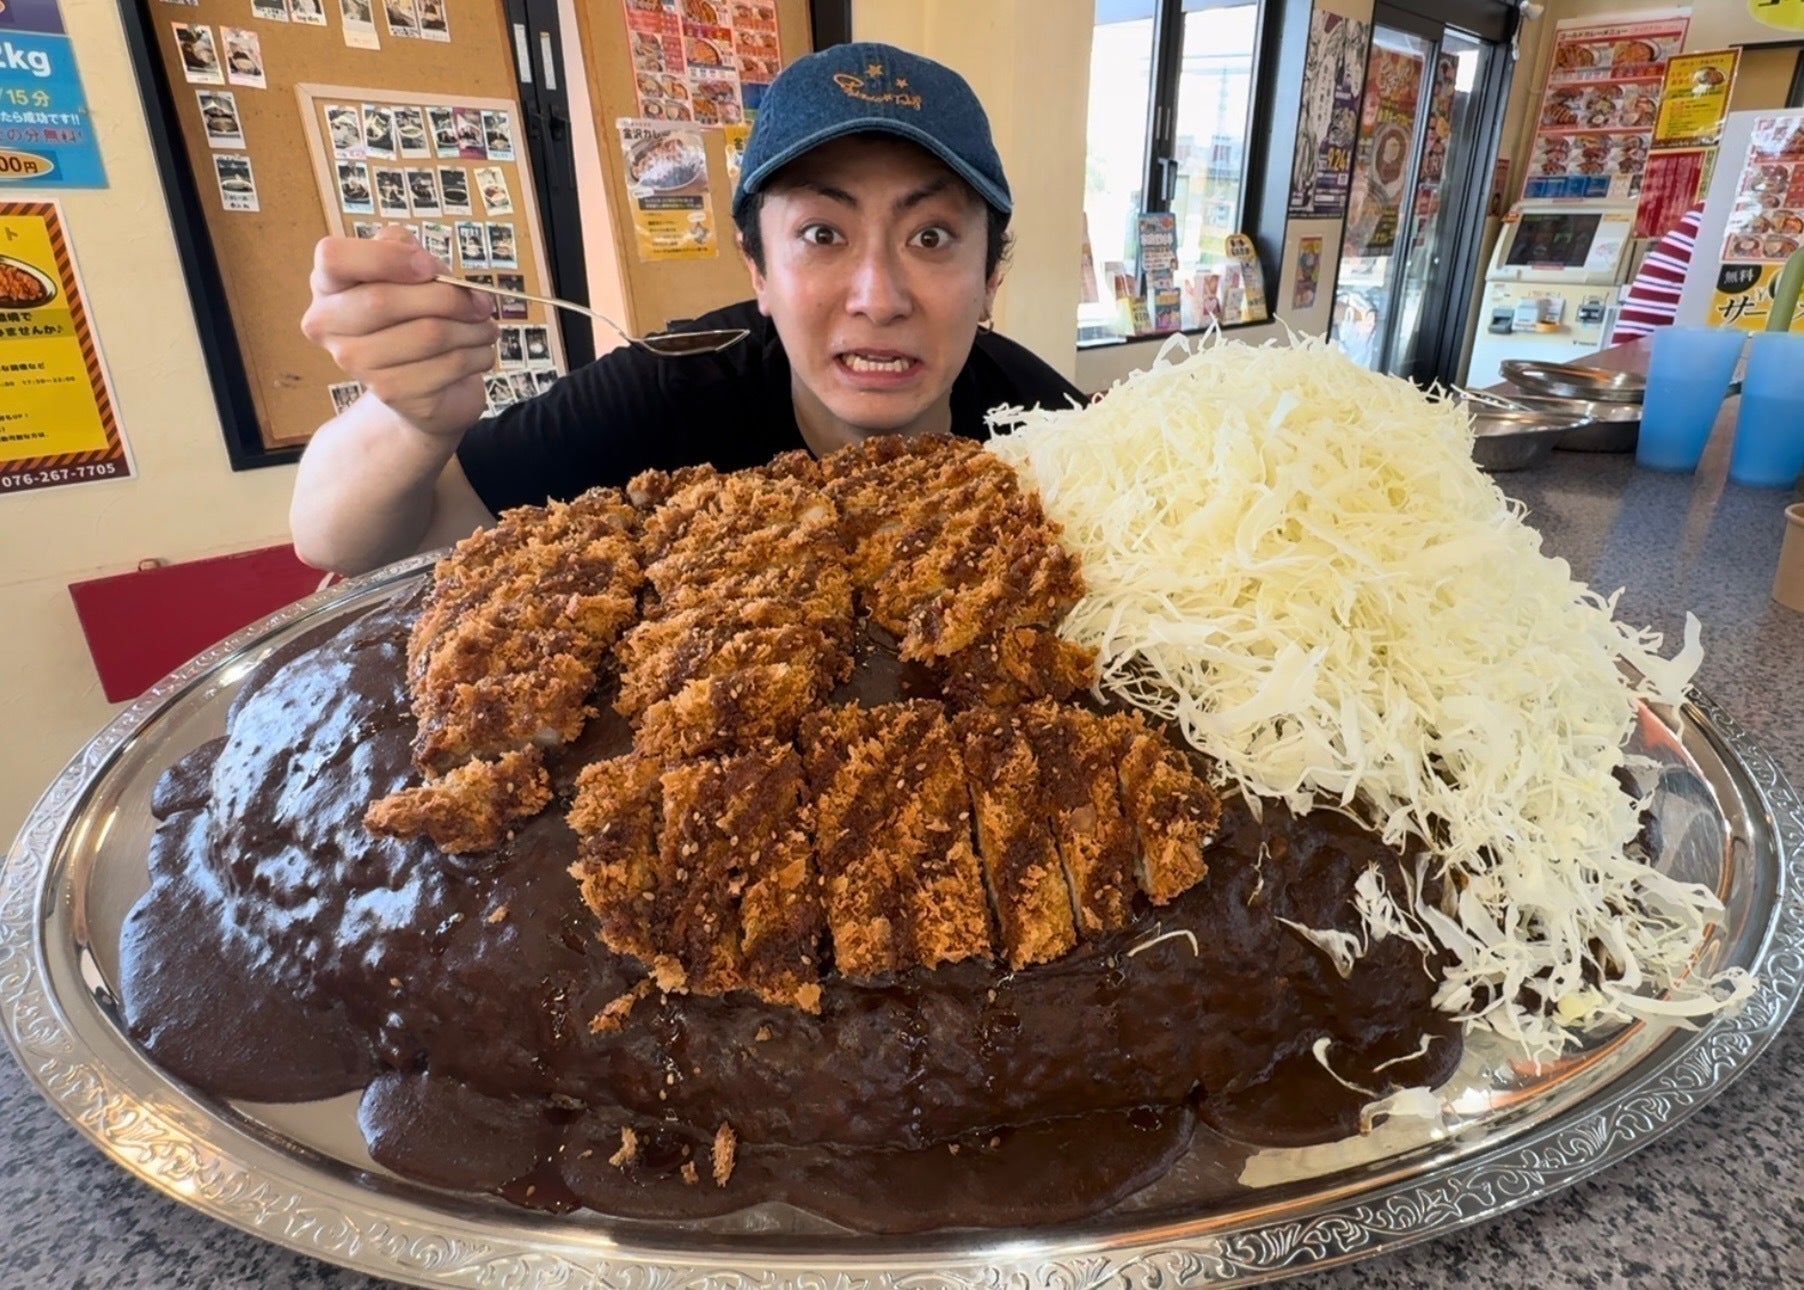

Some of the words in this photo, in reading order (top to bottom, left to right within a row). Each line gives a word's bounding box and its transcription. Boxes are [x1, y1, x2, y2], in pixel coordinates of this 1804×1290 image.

[623, 128, 671, 139] 金沢カレー
[1723, 268, 1754, 284] 無料
[2, 463, 116, 488] 076-267-7705
